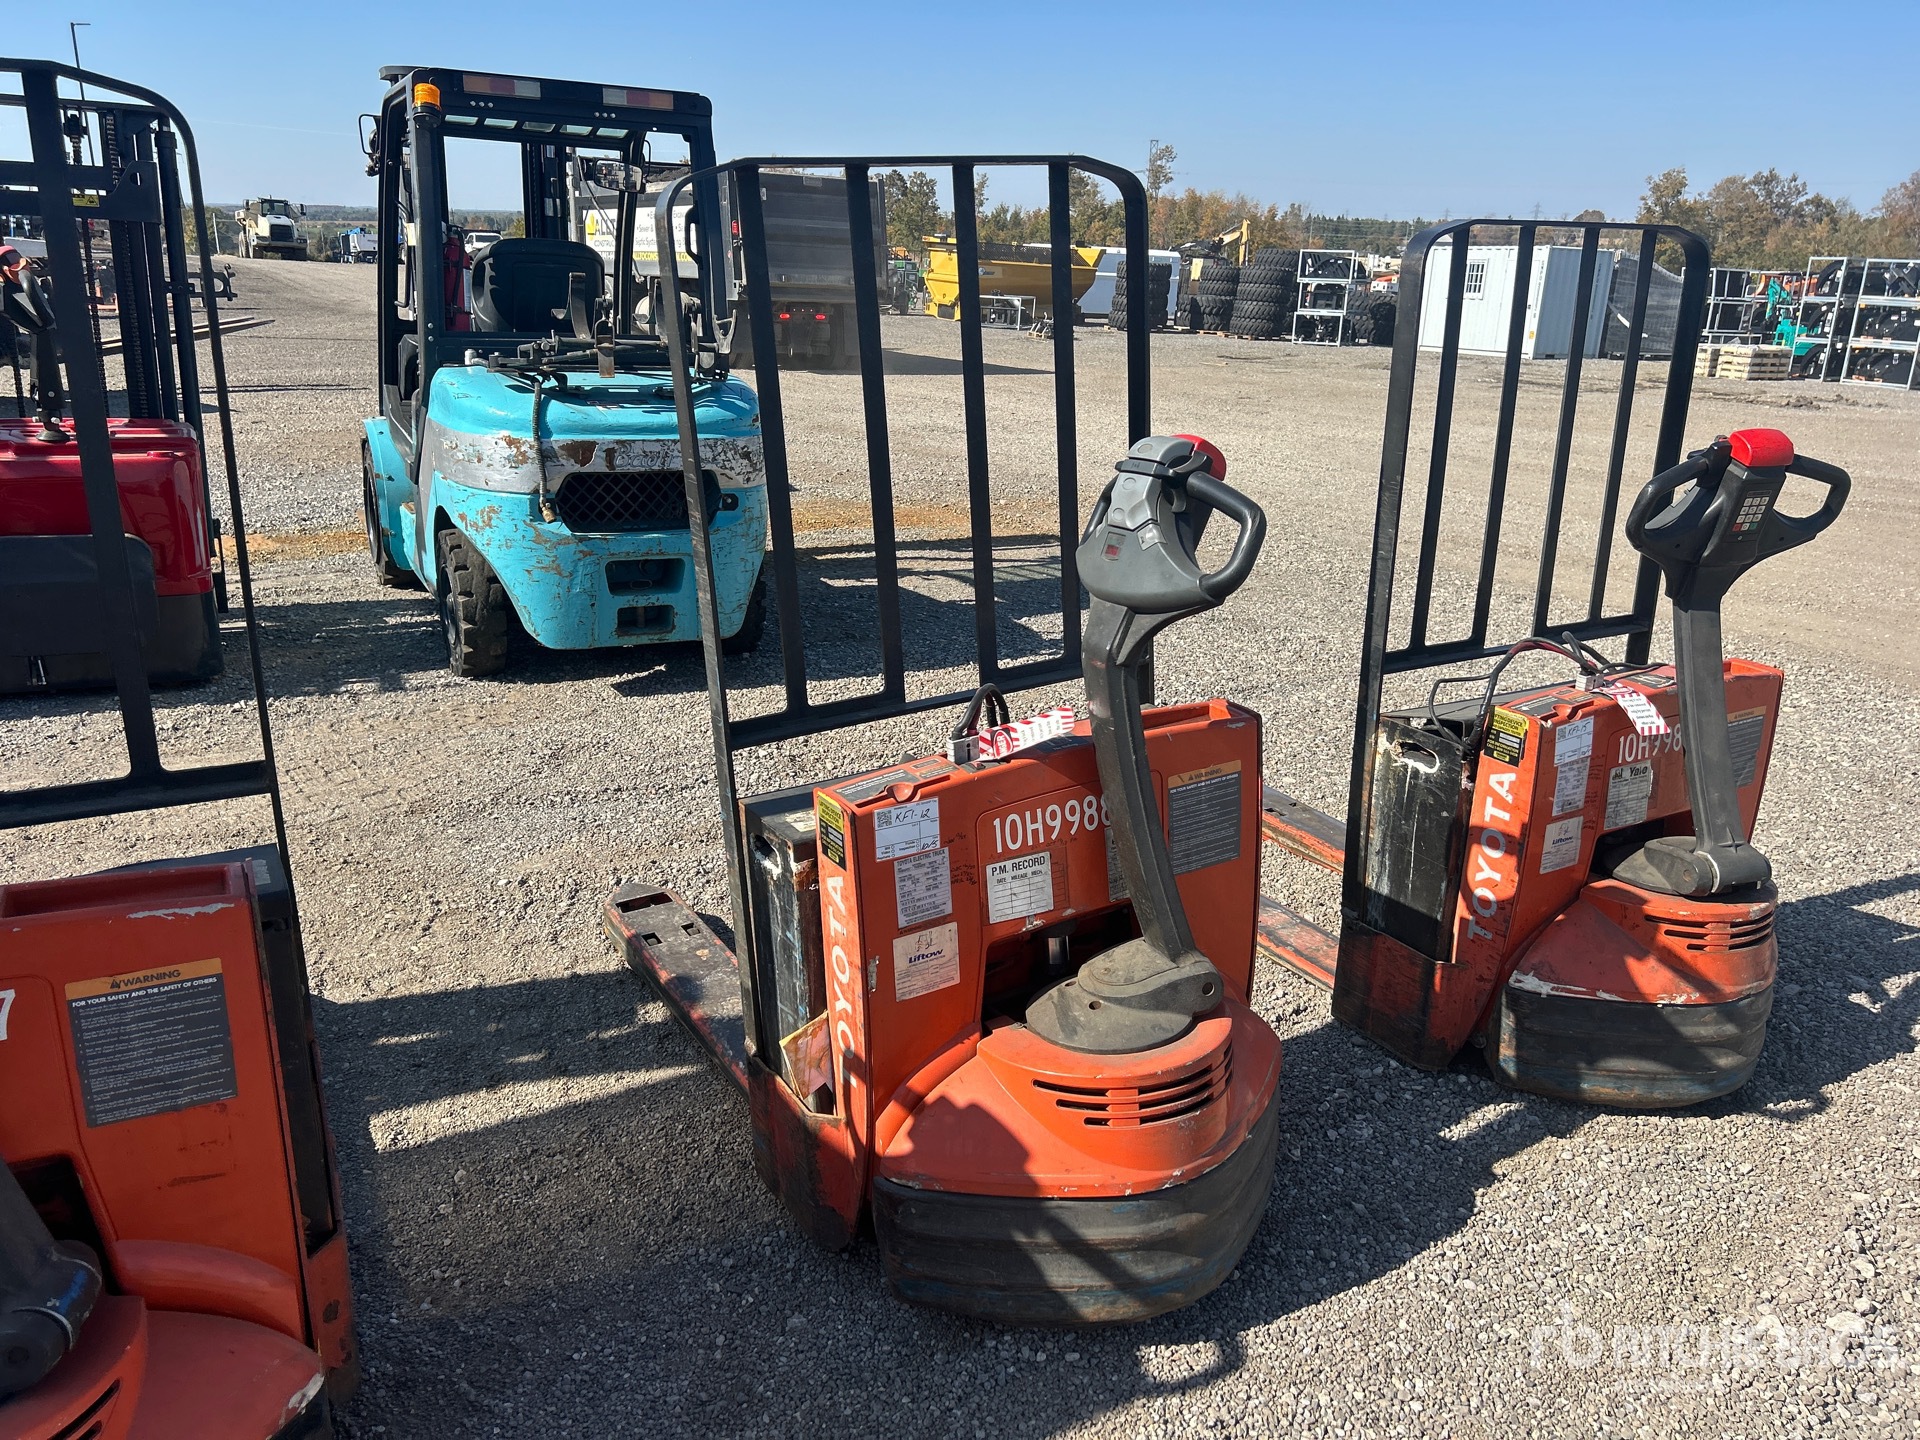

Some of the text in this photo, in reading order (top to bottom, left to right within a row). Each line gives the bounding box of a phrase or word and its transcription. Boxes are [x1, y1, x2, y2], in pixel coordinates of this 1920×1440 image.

[932, 849, 946, 858] TRUCK
[1467, 772, 1517, 940] TOYOTA
[991, 855, 1046, 877] P.M. RECORD
[908, 948, 944, 964] Liftow
[122, 969, 181, 989] WARNING
[826, 876, 858, 1089] TOYOTA
[72, 976, 217, 1008] FOR YOUR SAFETY AND THE SAFETY OF OTHERS
